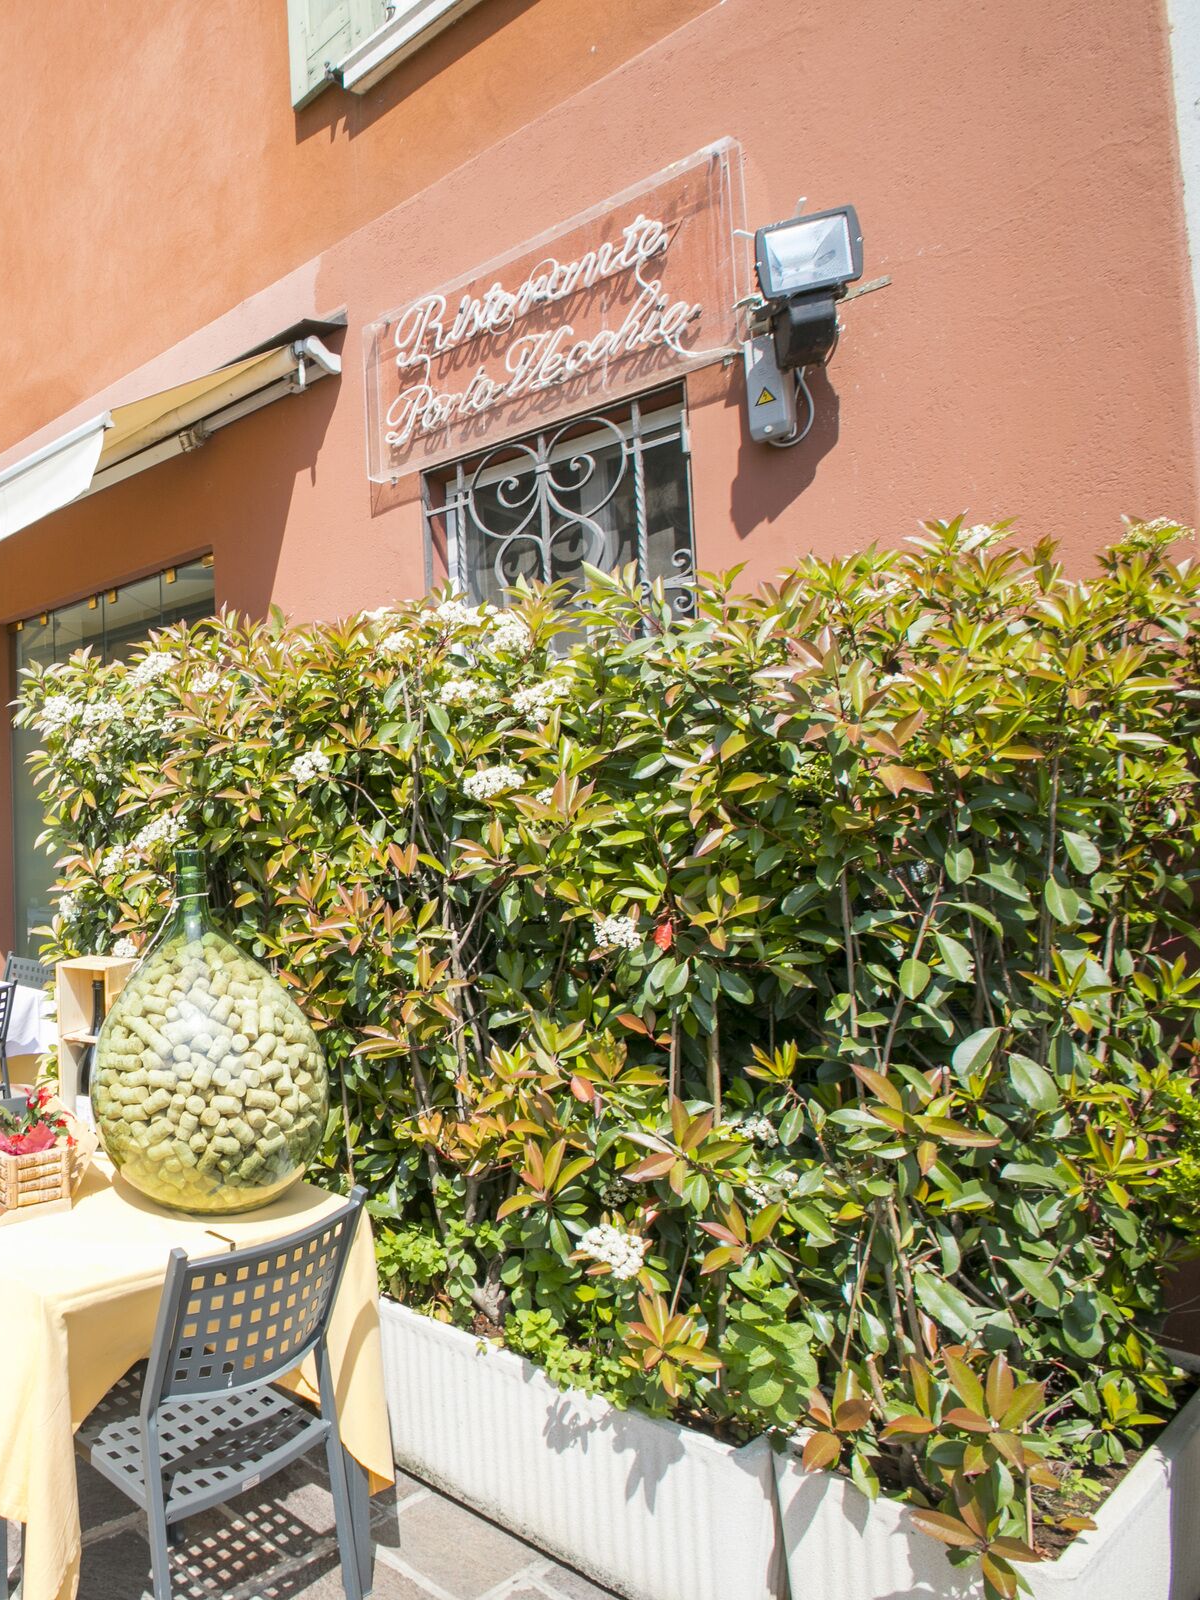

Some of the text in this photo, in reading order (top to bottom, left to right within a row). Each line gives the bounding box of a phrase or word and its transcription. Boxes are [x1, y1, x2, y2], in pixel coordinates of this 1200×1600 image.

[385, 278, 702, 448] Porto Vecchio
[395, 213, 669, 368] Ristorante
